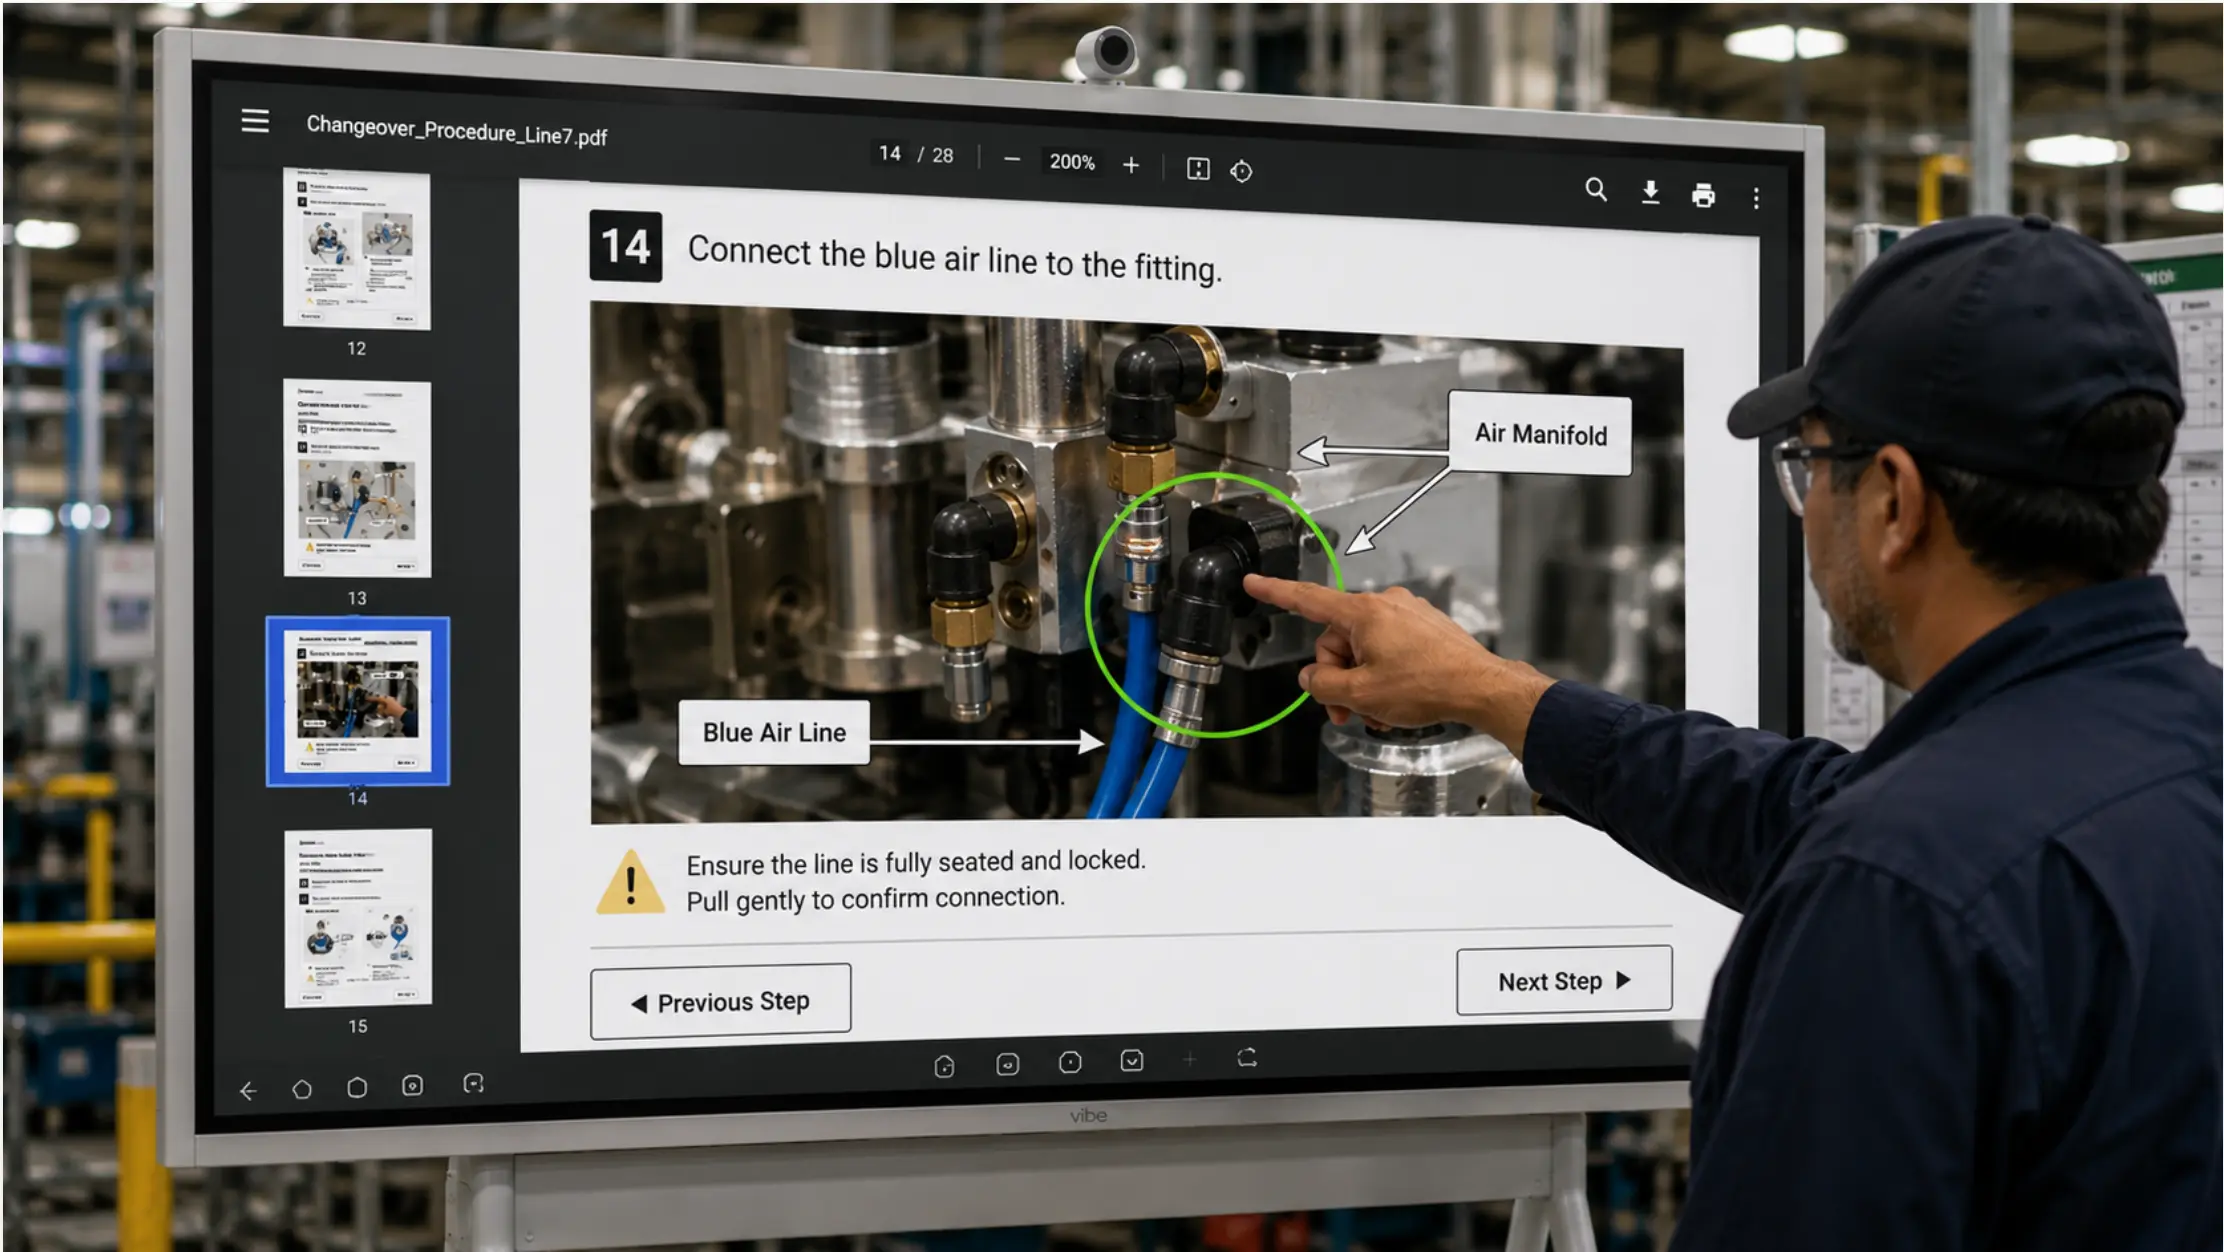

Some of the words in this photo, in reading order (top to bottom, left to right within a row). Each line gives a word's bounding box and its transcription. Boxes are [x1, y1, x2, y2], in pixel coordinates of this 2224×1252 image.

[307, 113, 608, 151] Changeover_Procedure_Line7.pdf
[880, 145, 901, 161] 14
[933, 147, 955, 164] 28
[1050, 153, 1096, 171] 200%
[602, 228, 651, 264] 14
[689, 234, 811, 267] Connect
[819, 239, 866, 268] the
[875, 241, 936, 272] blue
[944, 245, 981, 273] air
[989, 245, 1038, 275] line
[1045, 251, 1074, 277] to
[1081, 250, 1127, 279] the
[1134, 252, 1222, 289] fitting.
[347, 341, 367, 357] 12
[1475, 422, 1507, 443] Air
[1513, 423, 1608, 447] Manifold
[348, 590, 368, 606] 13
[704, 721, 753, 743] Blue
[759, 722, 793, 743] Air
[799, 722, 847, 743] Line
[348, 790, 369, 806] 14
[687, 855, 765, 876] Ensure
[770, 853, 807, 875] the
[814, 852, 854, 875] line
[861, 852, 879, 874] is
[885, 851, 932, 879] fully
[939, 849, 1014, 873] seated
[1021, 849, 1061, 872] and
[1069, 847, 1146, 871] locked.
[687, 890, 729, 912] Pull
[736, 889, 806, 917] gently
[811, 890, 835, 911] to
[841, 886, 928, 910] confirm
[935, 885, 1065, 908] connection.
[1499, 972, 1549, 992] Next
[1555, 971, 1603, 996] Step
[659, 992, 754, 1014] Previous
[760, 990, 810, 1016] Step
[348, 1018, 368, 1034] 15
[1069, 1107, 1108, 1124] vibe
